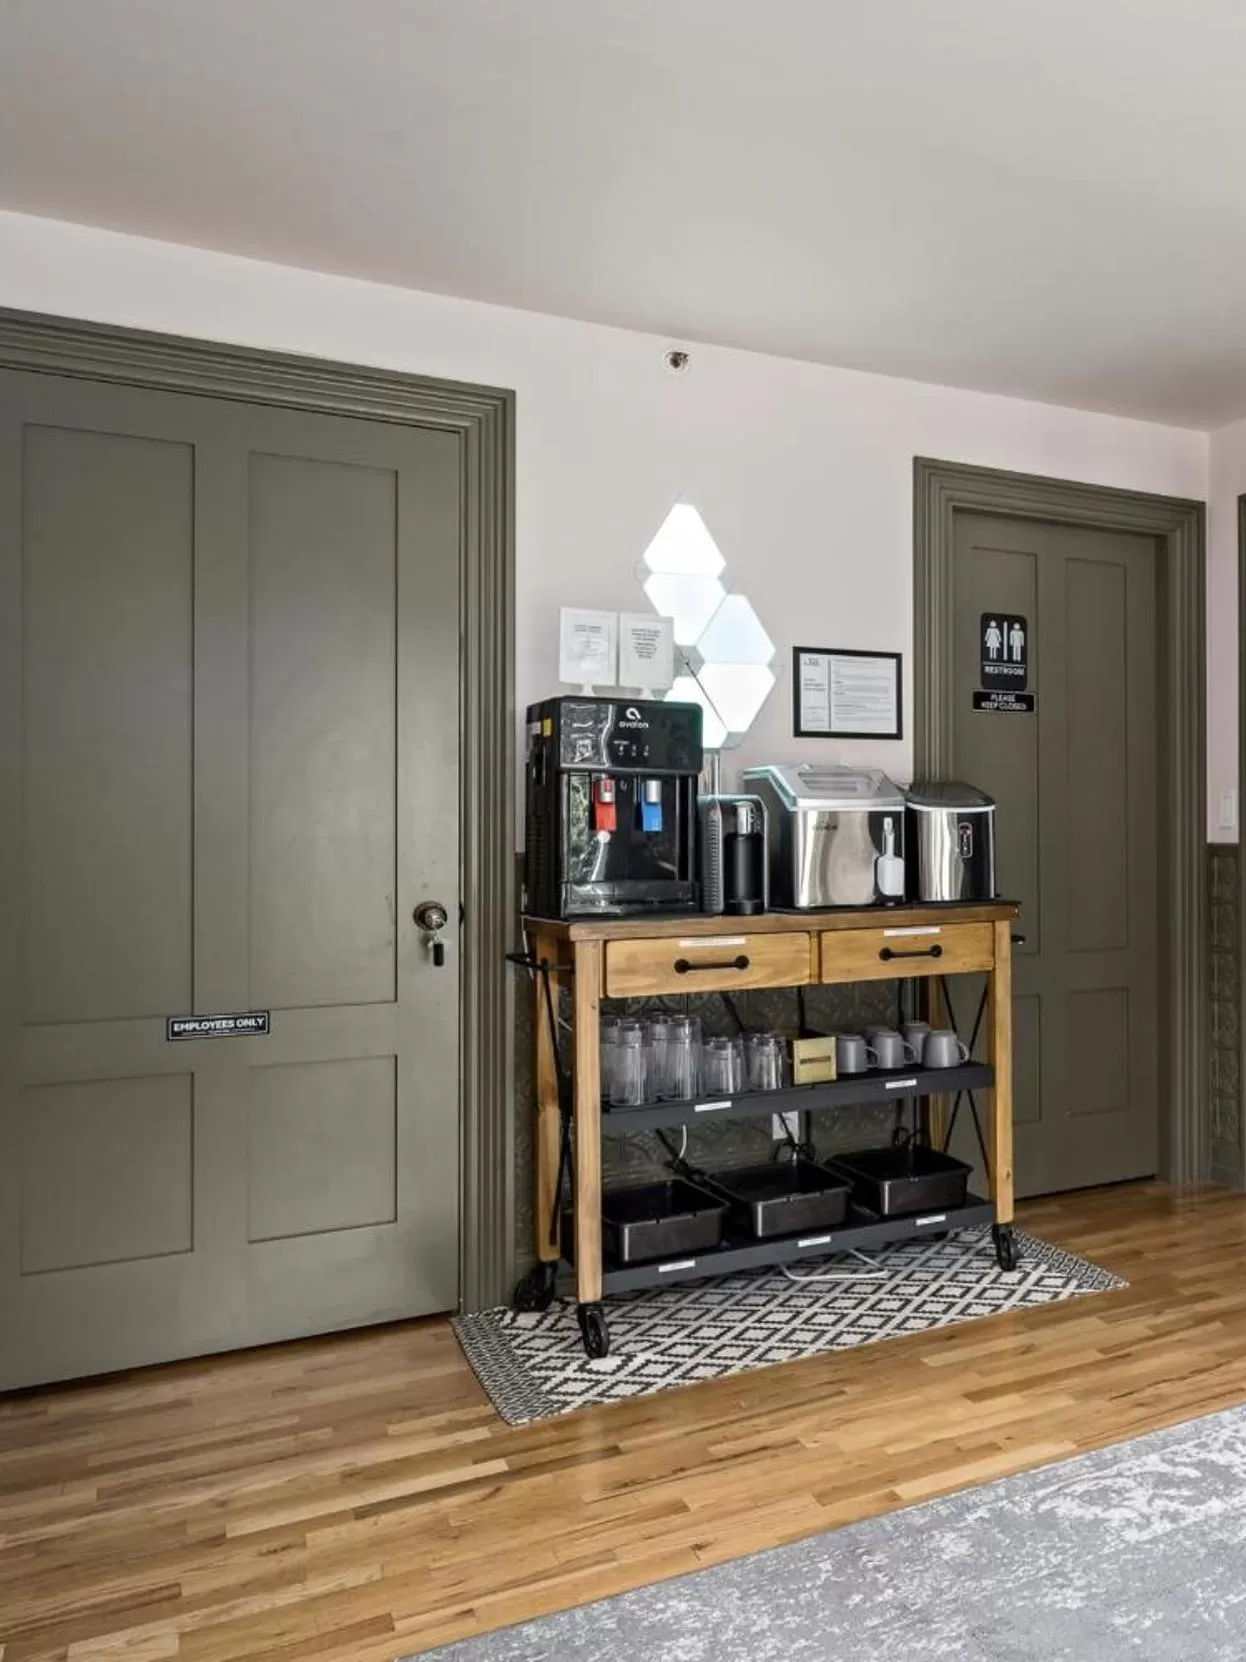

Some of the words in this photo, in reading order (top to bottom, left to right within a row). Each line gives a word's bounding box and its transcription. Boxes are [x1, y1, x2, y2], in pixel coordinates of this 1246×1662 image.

[983, 666, 1025, 675] RESTROOM
[990, 694, 1016, 702] PLEASE
[174, 1019, 235, 1032] EMPLOYEES
[236, 1017, 265, 1028] ONLY
